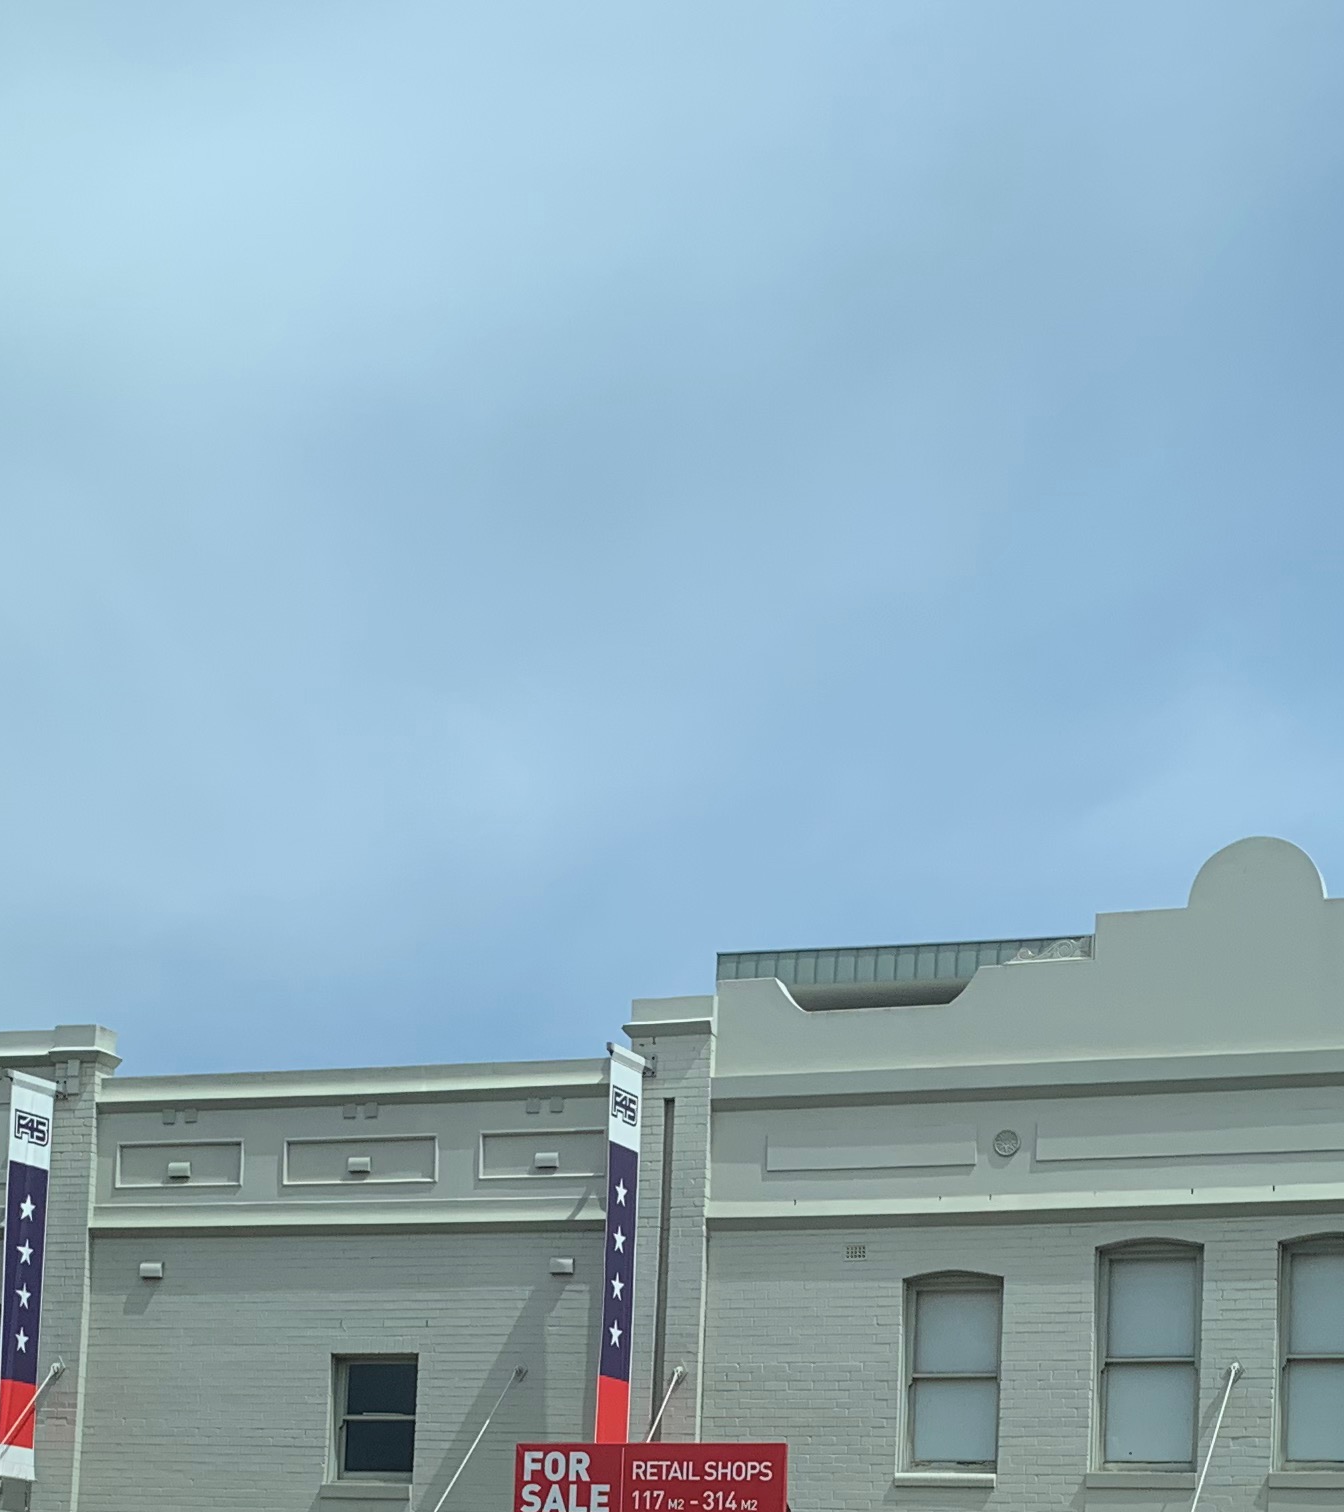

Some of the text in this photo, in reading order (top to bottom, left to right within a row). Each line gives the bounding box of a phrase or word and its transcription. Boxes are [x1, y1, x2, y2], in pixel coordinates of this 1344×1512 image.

[611, 1085, 638, 1127] F45
[15, 1109, 49, 1147] F45
[523, 1451, 590, 1481] FOR
[632, 1461, 772, 1481] RETAIL SHOPS
[632, 1490, 664, 1510] 117
[703, 1491, 737, 1511] 314
